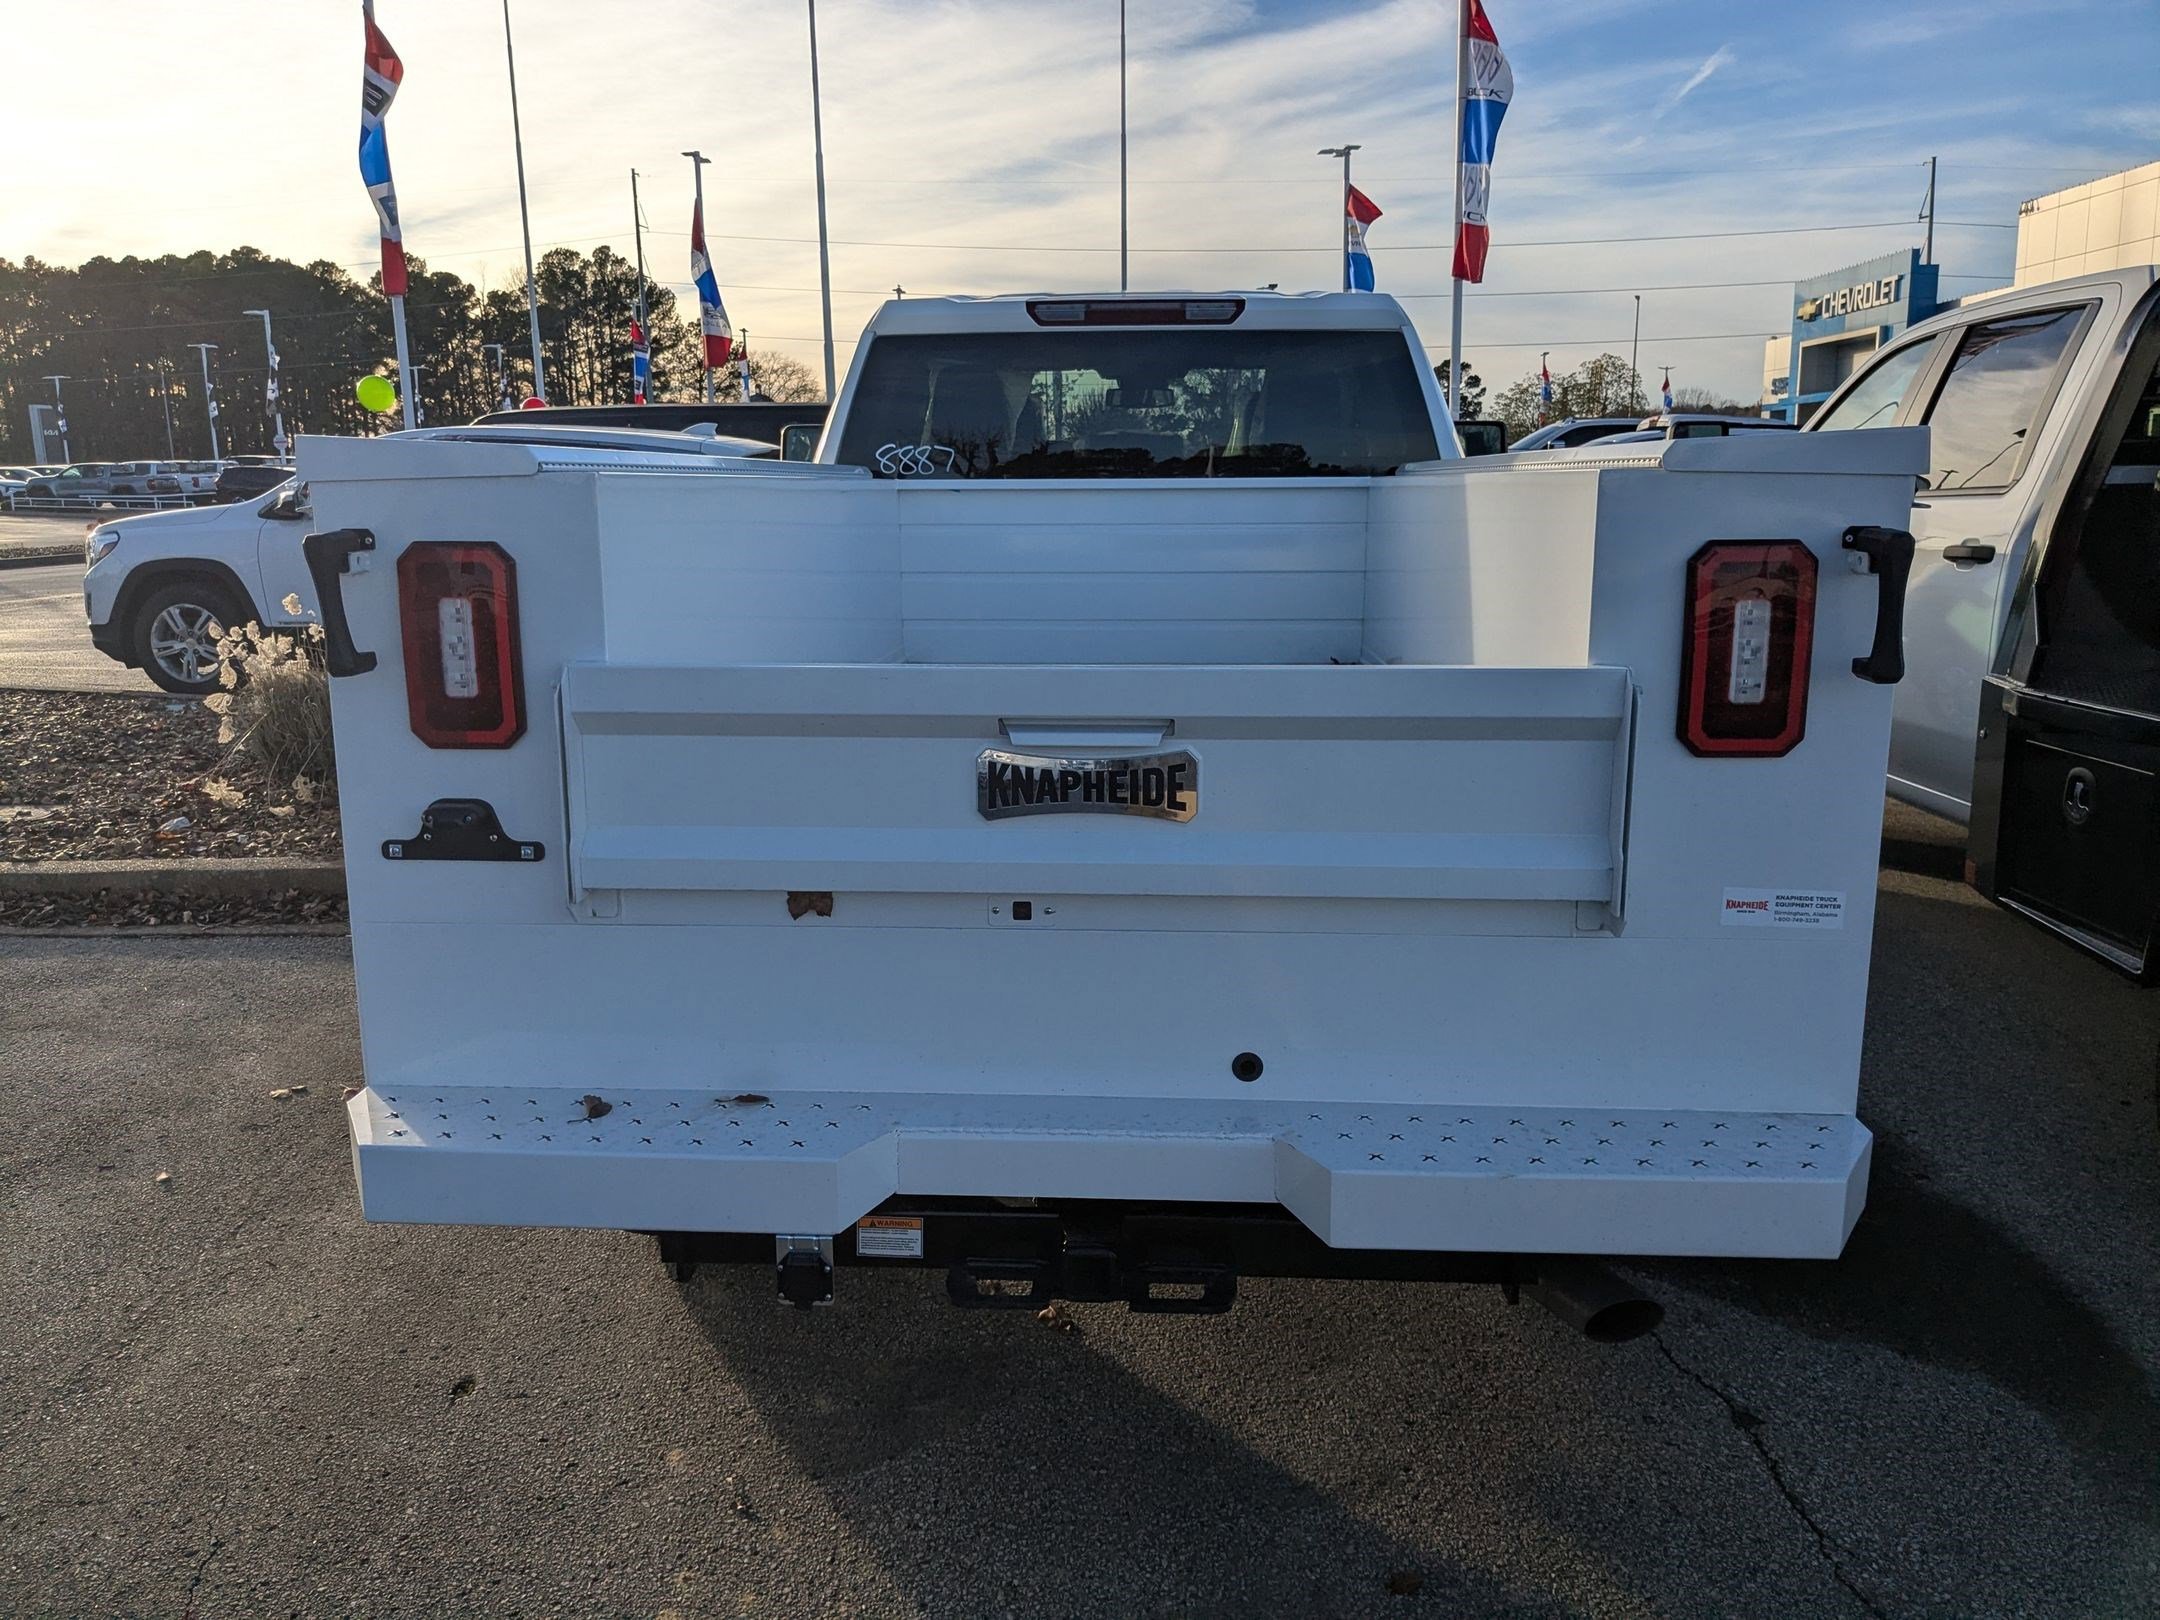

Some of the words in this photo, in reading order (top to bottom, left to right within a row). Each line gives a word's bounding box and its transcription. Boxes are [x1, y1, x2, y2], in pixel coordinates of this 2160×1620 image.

[1822, 274, 1898, 318] CHEVROLET
[875, 443, 955, 475] 8887
[987, 762, 1187, 812] KNAPHEIDE
[1725, 899, 1769, 911] KNAPHEIDE
[1774, 901, 1813, 909] EQUIPMENT
